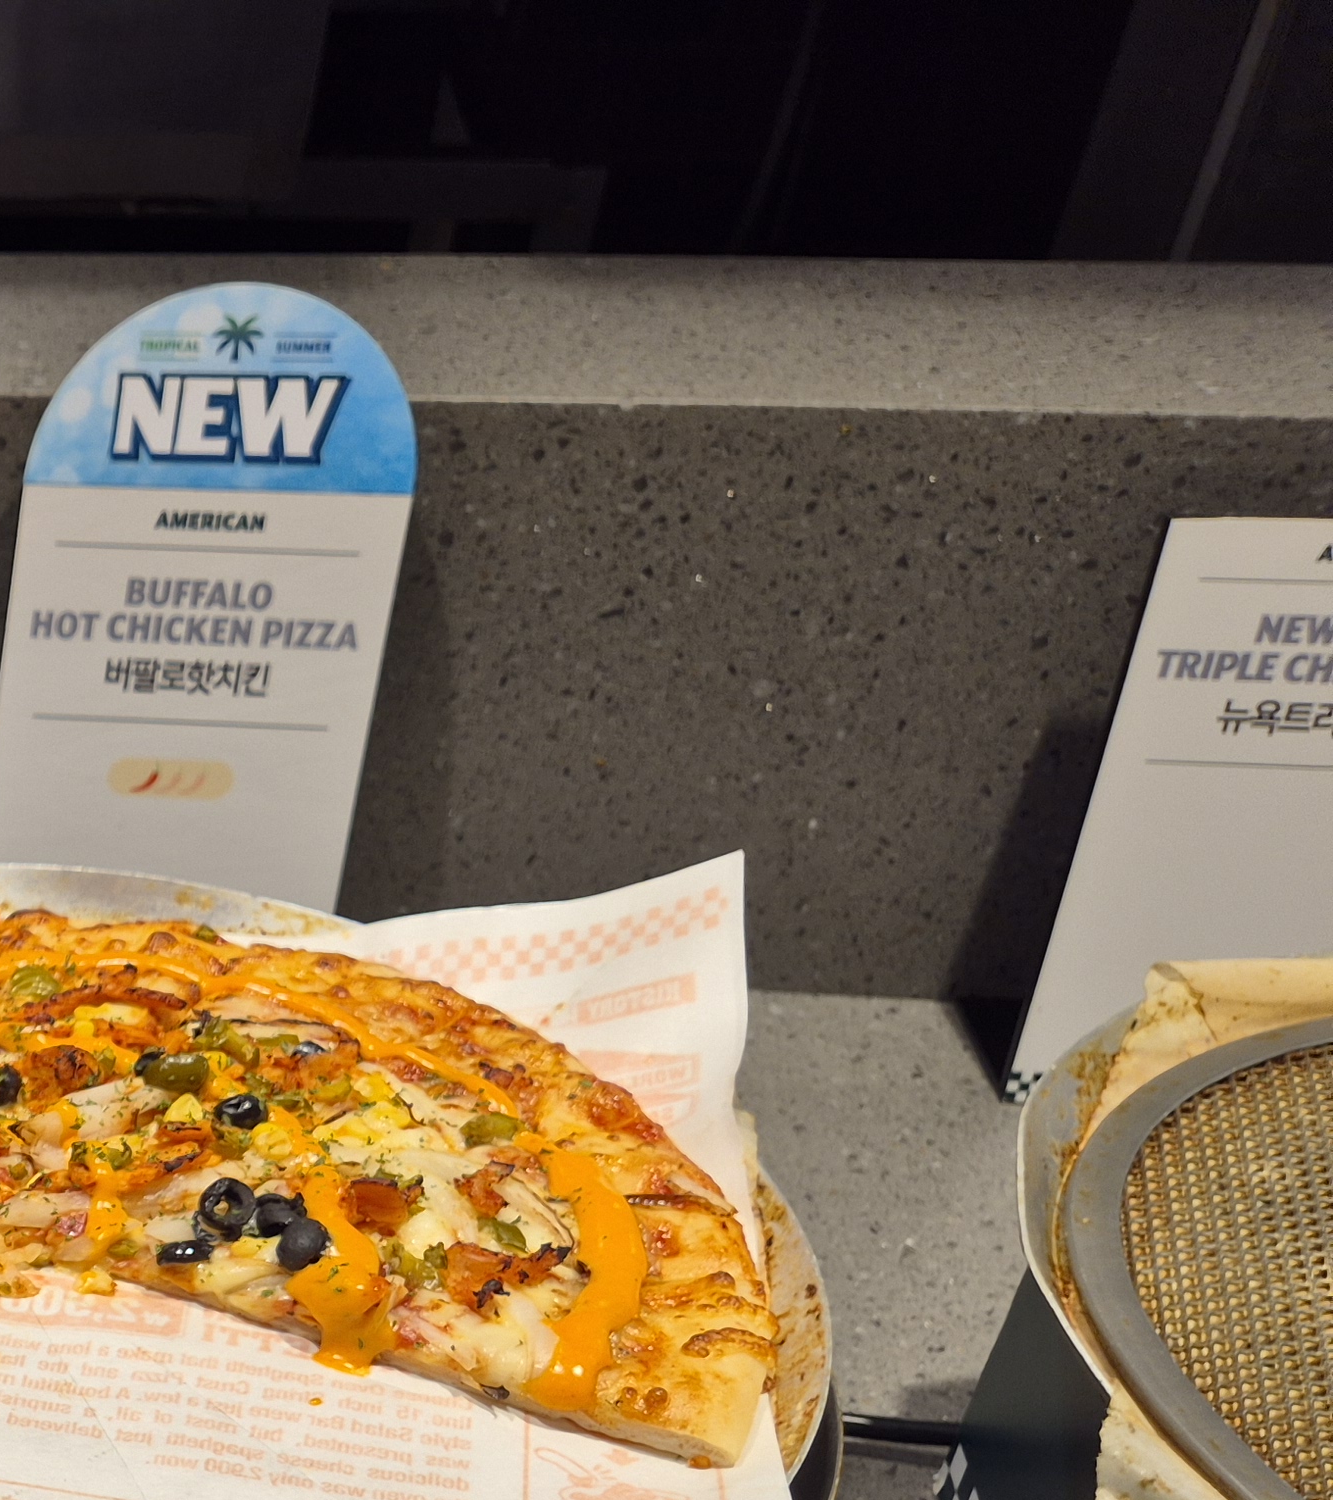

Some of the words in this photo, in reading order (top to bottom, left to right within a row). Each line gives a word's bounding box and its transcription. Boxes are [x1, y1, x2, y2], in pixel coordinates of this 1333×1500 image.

[275, 340, 332, 355] SUMMER
[110, 372, 351, 465] NEW
[155, 511, 266, 533] AMERICAN
[124, 578, 274, 612] BUFFALO
[30, 610, 100, 641] HOT
[107, 613, 252, 648] CHICKEN
[261, 620, 357, 651] PIZZA
[104, 658, 272, 697] 버팔로핫치킨
[1157, 650, 1279, 682] TRIPLE
